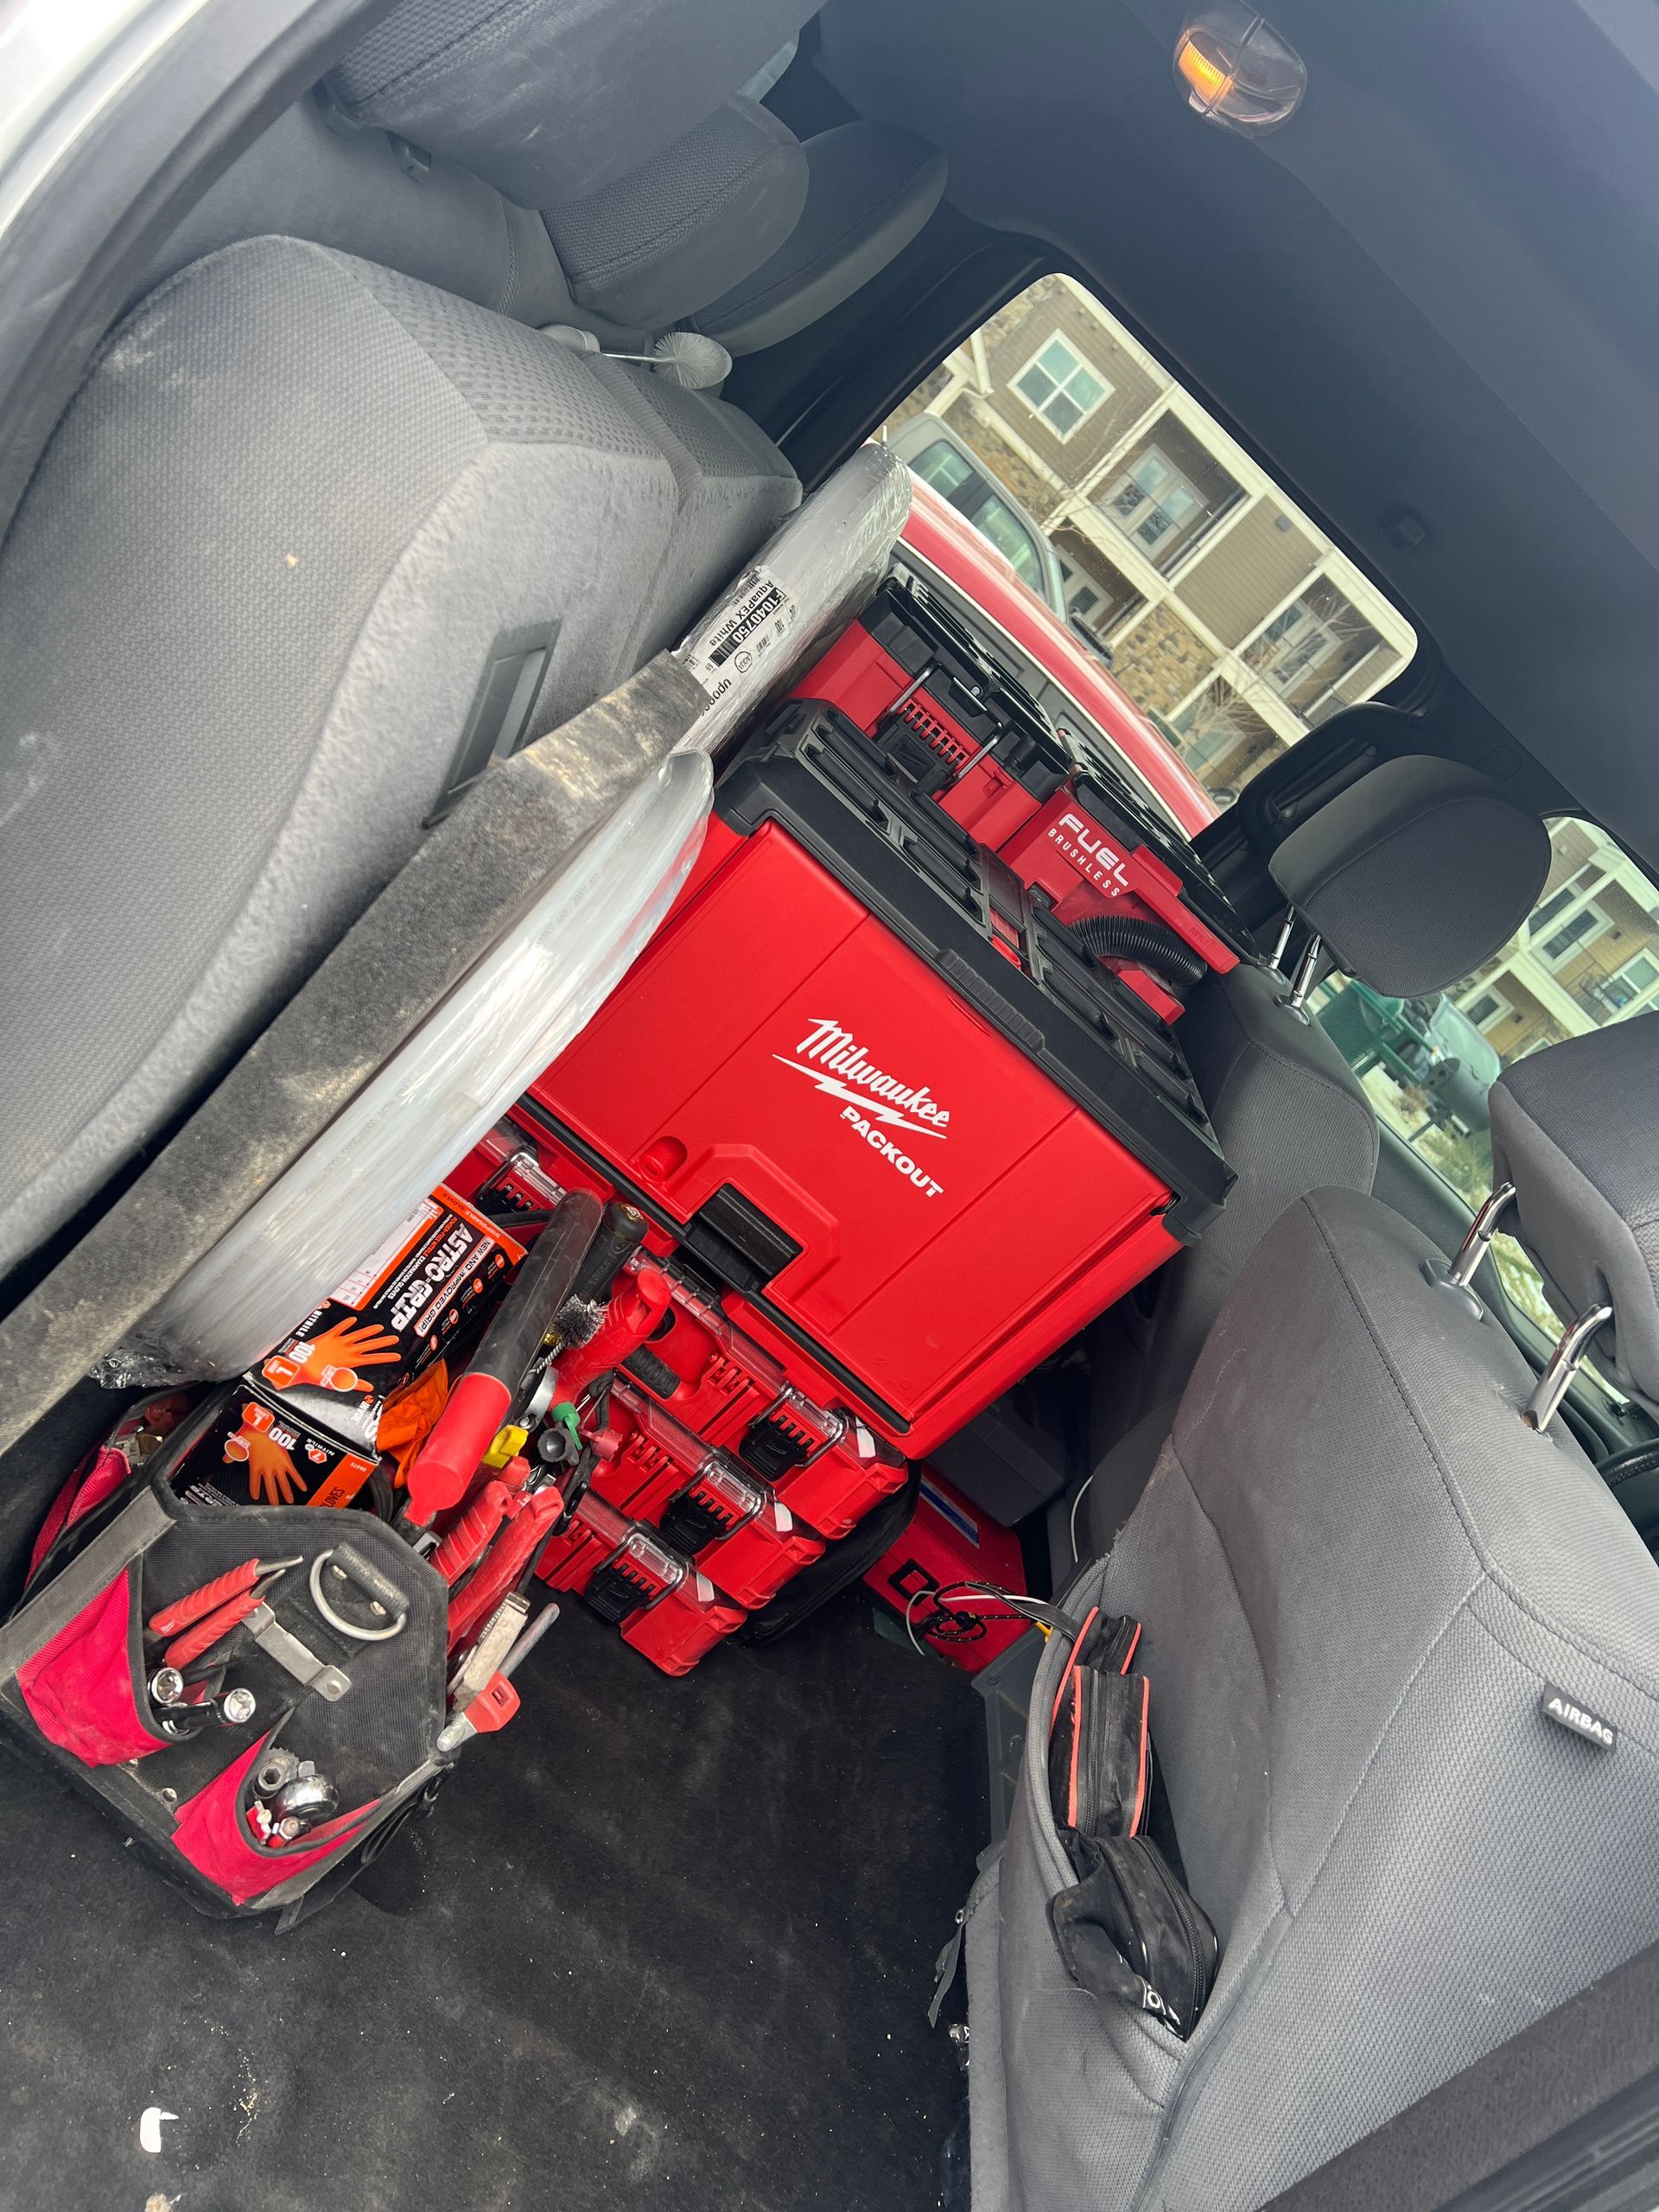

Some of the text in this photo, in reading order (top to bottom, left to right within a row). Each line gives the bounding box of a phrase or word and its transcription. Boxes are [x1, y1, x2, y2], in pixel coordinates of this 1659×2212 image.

[734, 580, 773, 620] AquaPEX
[731, 588, 785, 644] F1040750
[709, 619, 737, 647] White
[737, 654, 752, 670] AQUA
[1047, 828, 1120, 897] BRUSHLESS
[1058, 813, 1128, 887] FUEL
[796, 1018, 950, 1127] Milwaukee
[840, 1106, 944, 1198] PACKOUT
[465, 1210, 500, 1238] DISPOSABLE
[476, 1240, 491, 1255] NEW
[400, 1255, 425, 1283] EXAMINATION
[465, 1254, 480, 1271] AND
[387, 1223, 474, 1332] ASTRO-GRIP
[387, 1281, 403, 1300] GLOVES
[295, 1308, 322, 1338] NITRILE
[418, 1309, 436, 1332] GRIP!
[288, 1340, 316, 1365] 100
[276, 1366, 293, 1377] L
[254, 1413, 262, 1426] L
[268, 1427, 296, 1452] 100
[306, 1438, 334, 1456] NITRILE
[319, 1486, 345, 1507] LOVES
[1548, 1697, 1614, 1745] AIRBAG
